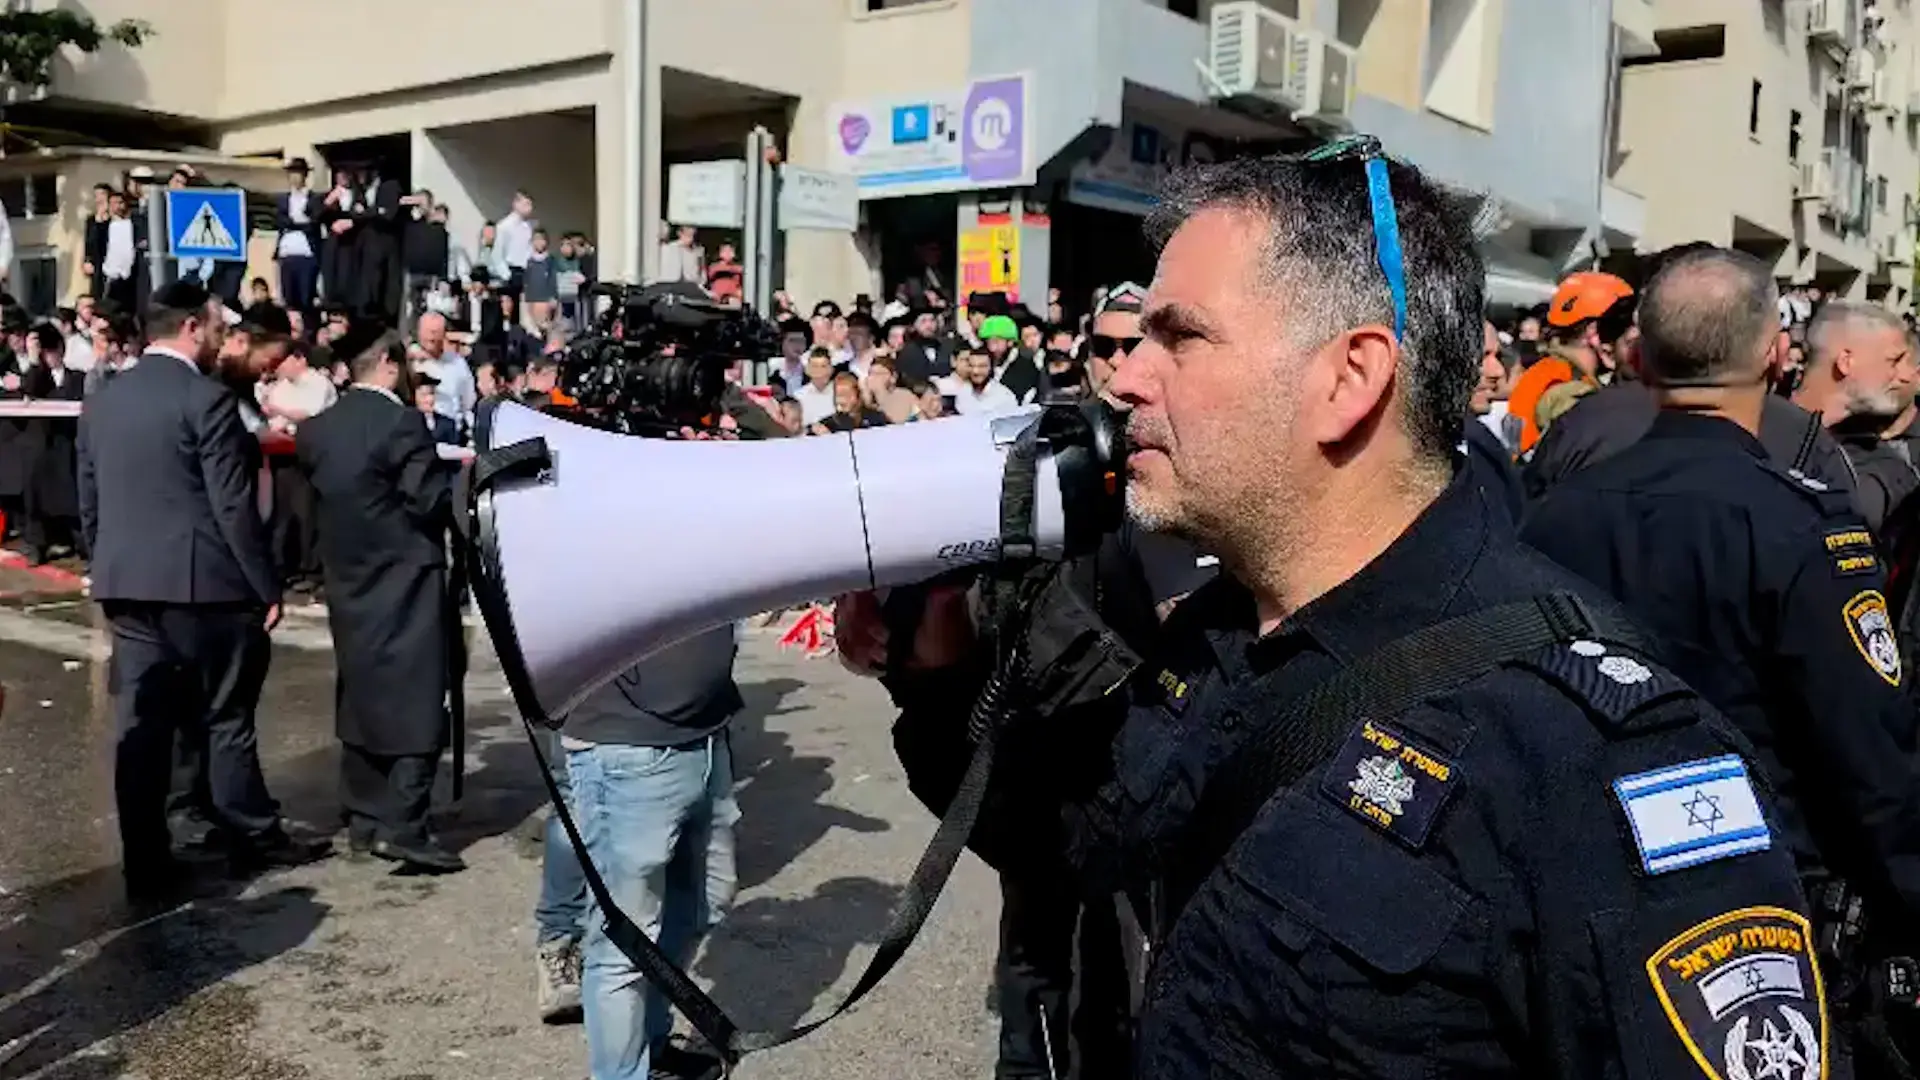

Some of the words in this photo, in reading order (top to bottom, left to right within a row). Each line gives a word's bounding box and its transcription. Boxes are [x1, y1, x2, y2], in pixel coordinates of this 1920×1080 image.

[1362, 721, 1400, 751] ישראל
[1400, 746, 1450, 782] משטרת
[1740, 926, 1803, 952] משטרת
[1667, 932, 1739, 980] ישראל
